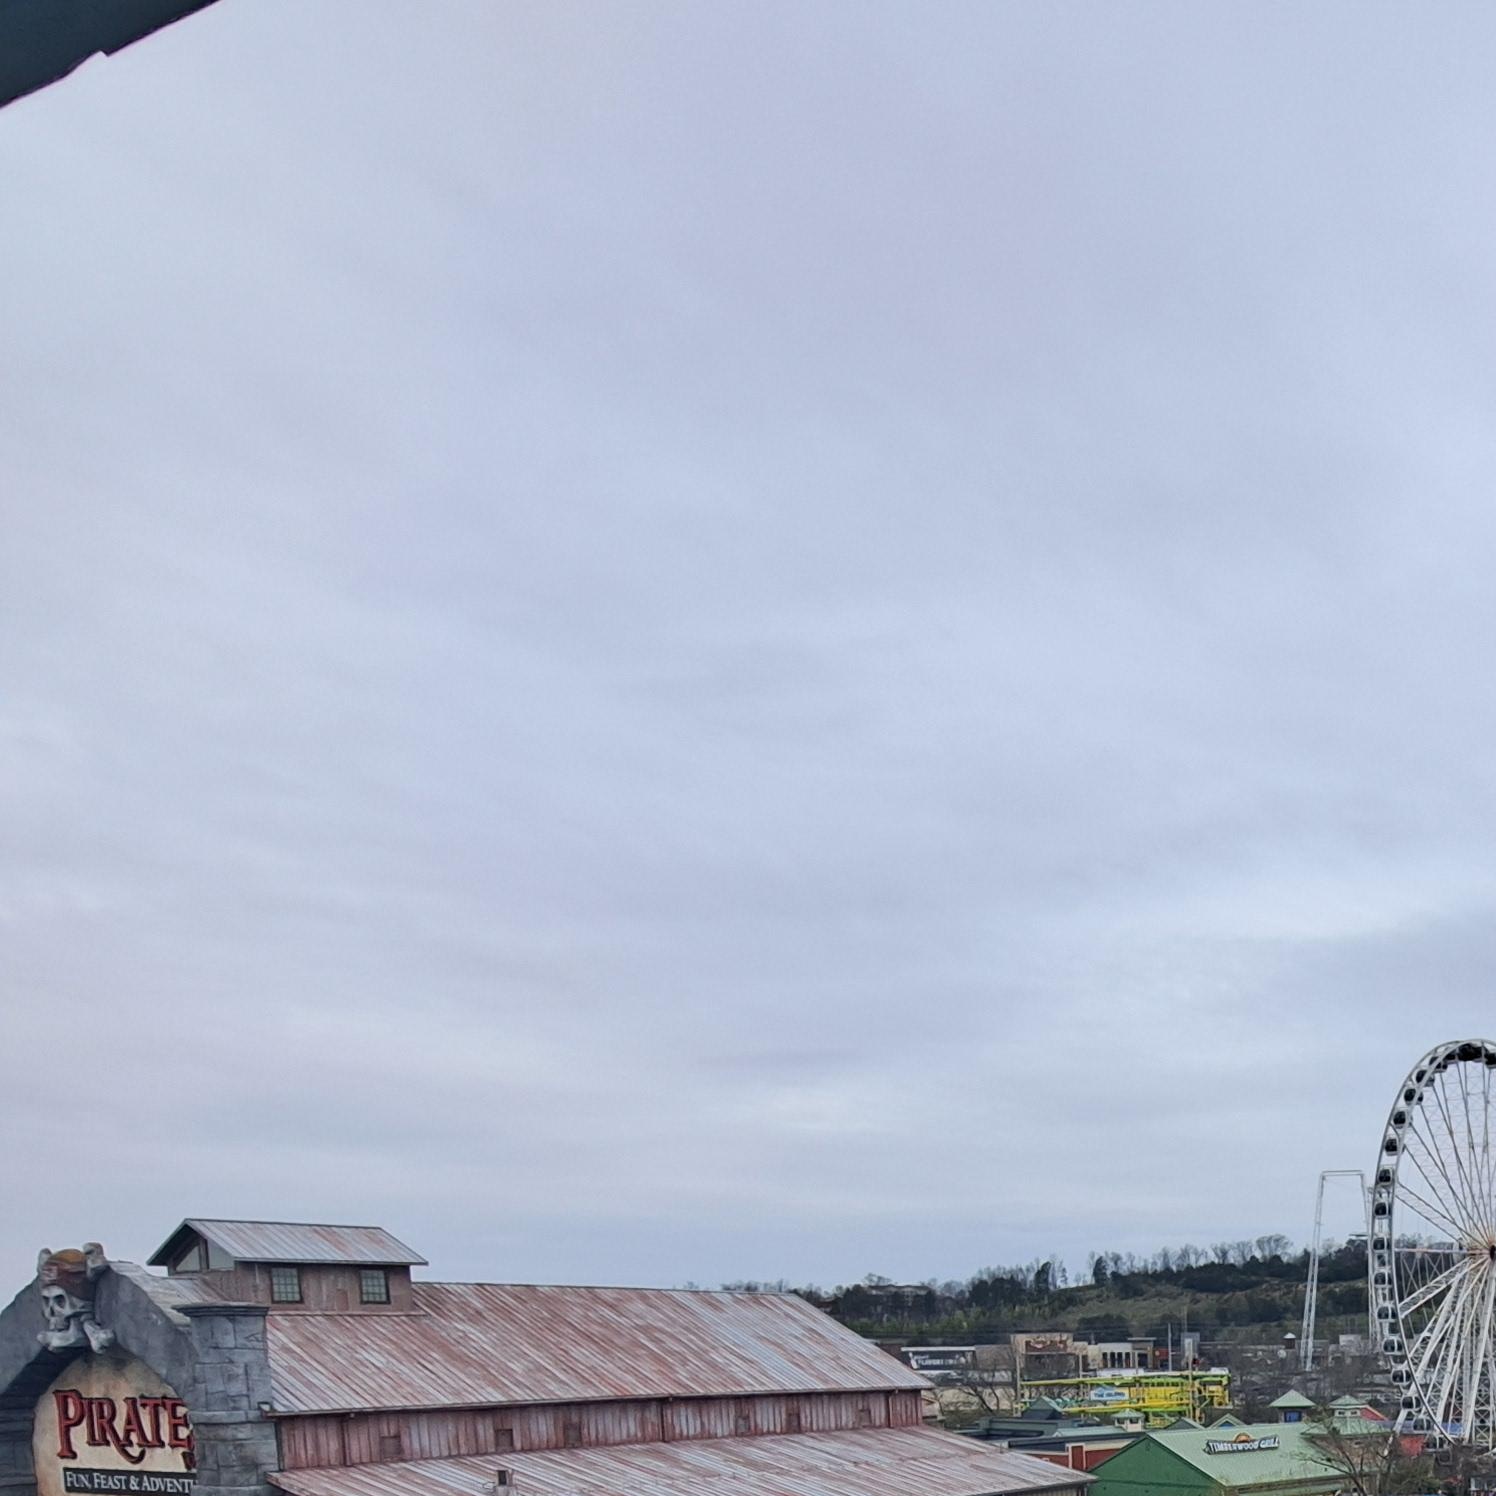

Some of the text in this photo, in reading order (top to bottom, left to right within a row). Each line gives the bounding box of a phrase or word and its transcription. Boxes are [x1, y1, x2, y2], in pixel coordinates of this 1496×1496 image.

[65, 1471, 92, 1489] FUN,
[93, 1472, 127, 1490] FEAST
[129, 1475, 140, 1490] &
